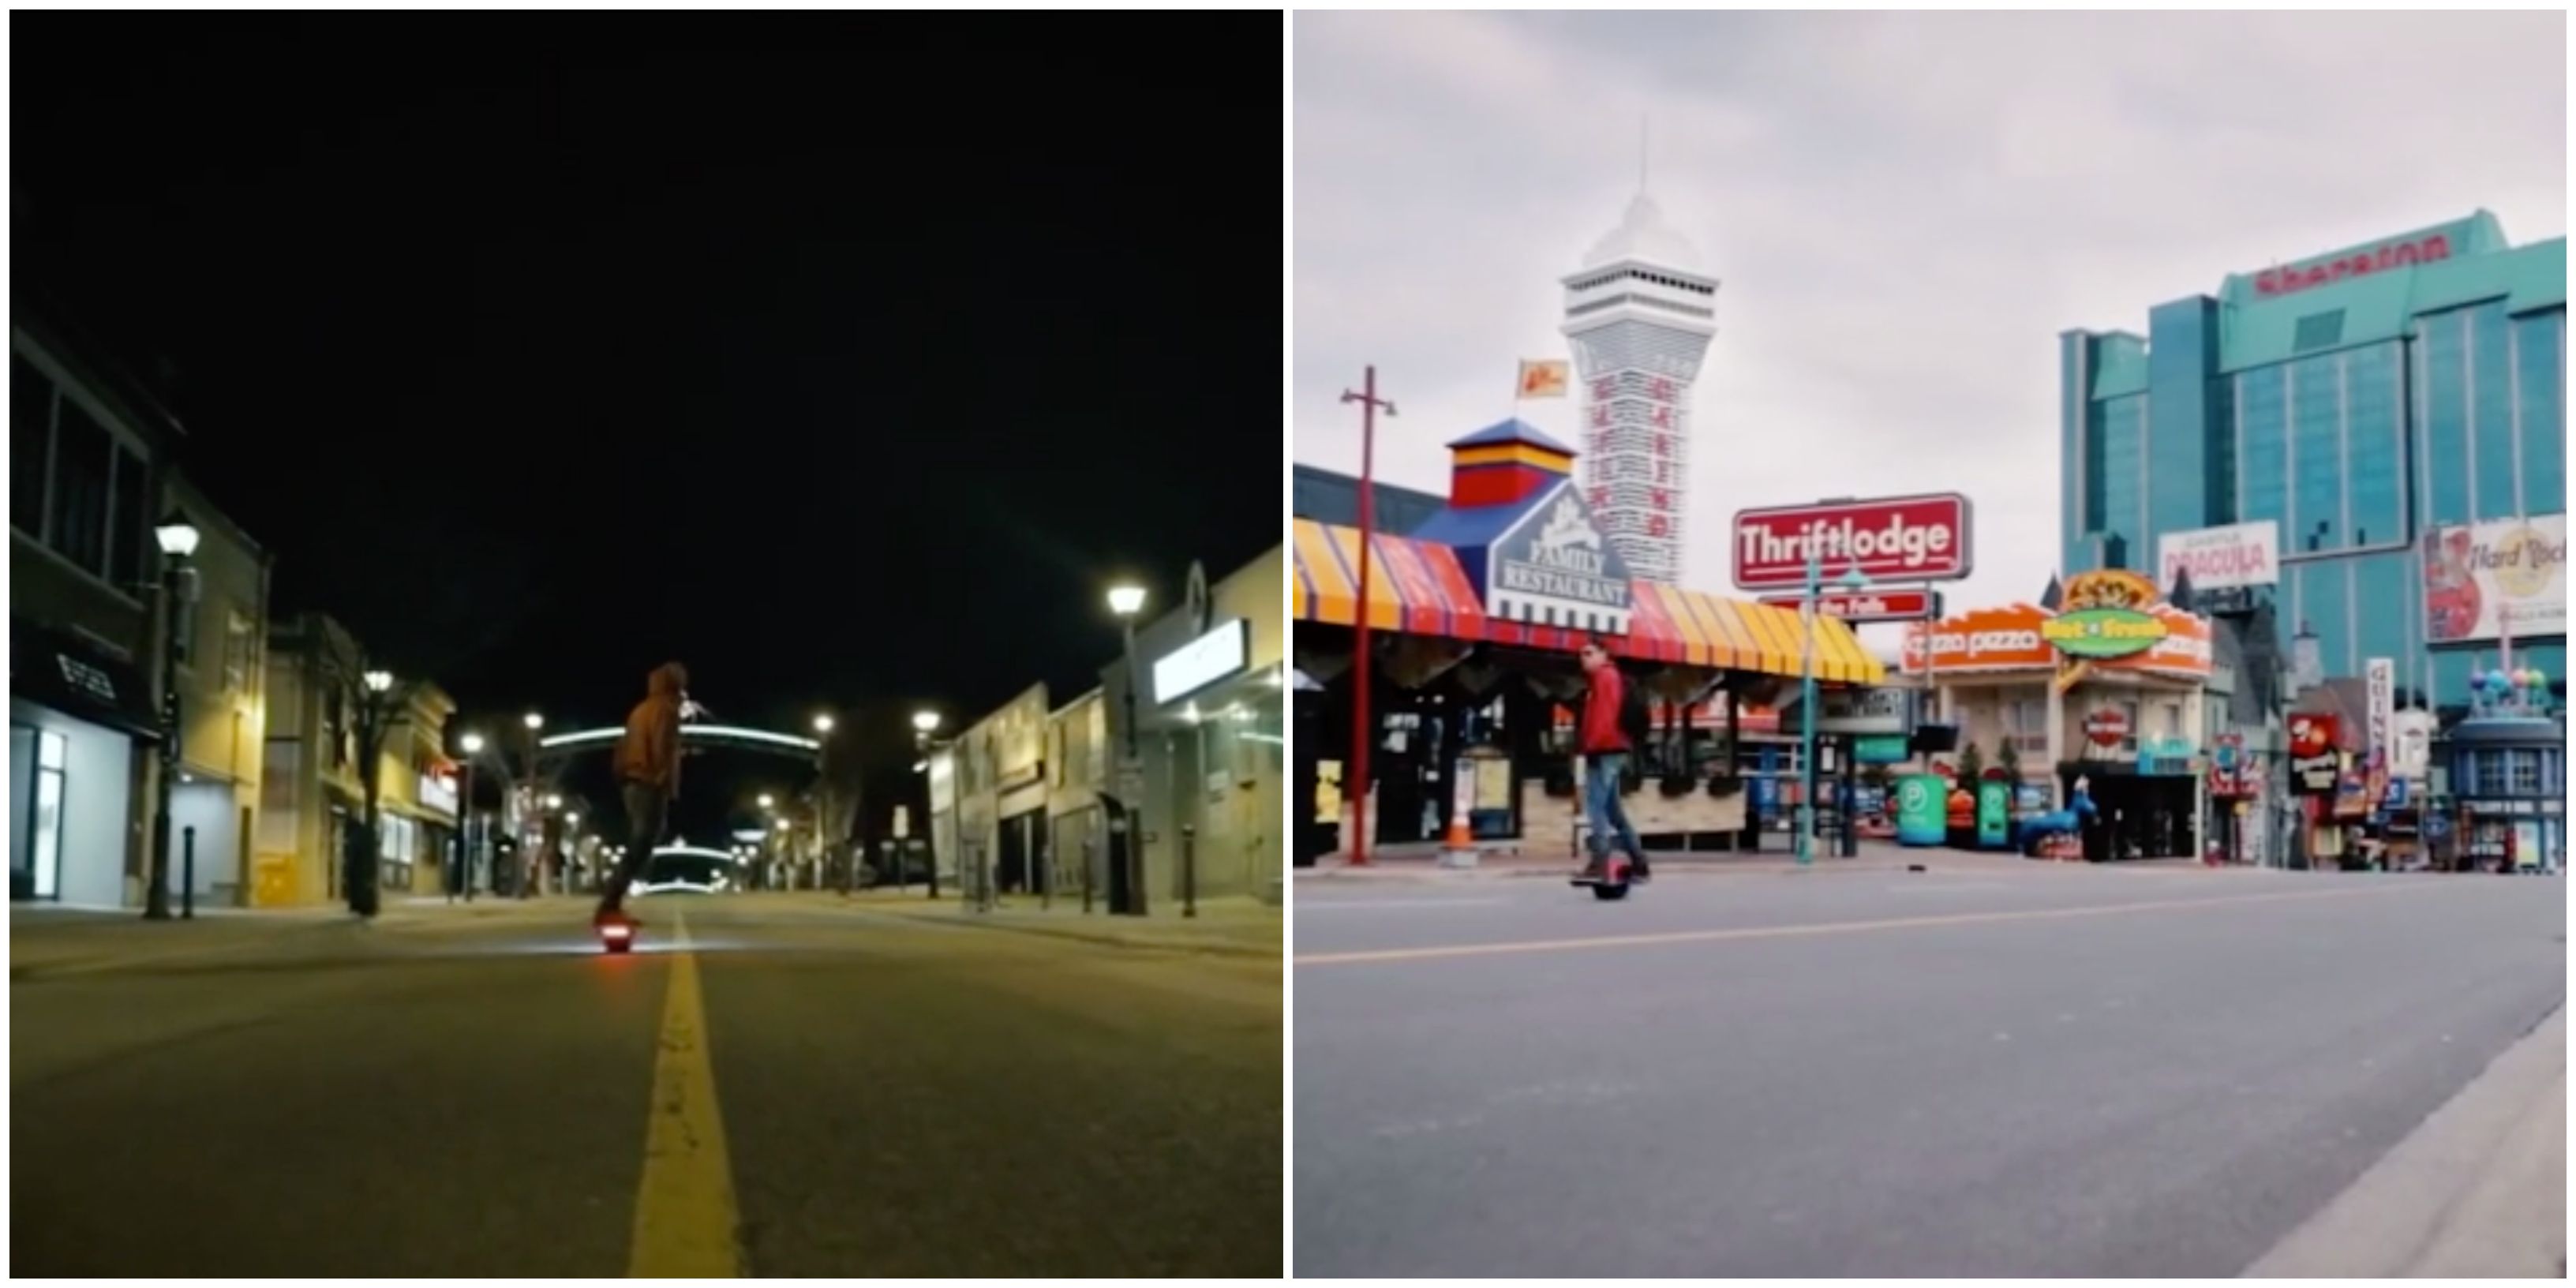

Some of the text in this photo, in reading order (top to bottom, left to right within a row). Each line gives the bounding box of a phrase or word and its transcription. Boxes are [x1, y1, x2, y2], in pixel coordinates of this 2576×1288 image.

[2255, 234, 2451, 294] Sheraton
[1530, 540, 1606, 576] FAMILY
[1740, 513, 1950, 567] Thriftlodge
[2470, 541, 2523, 570] Hard
[2165, 543, 2265, 581] DRACULA
[1504, 565, 1626, 606] RESTAURANT
[1849, 596, 1888, 614] Falls
